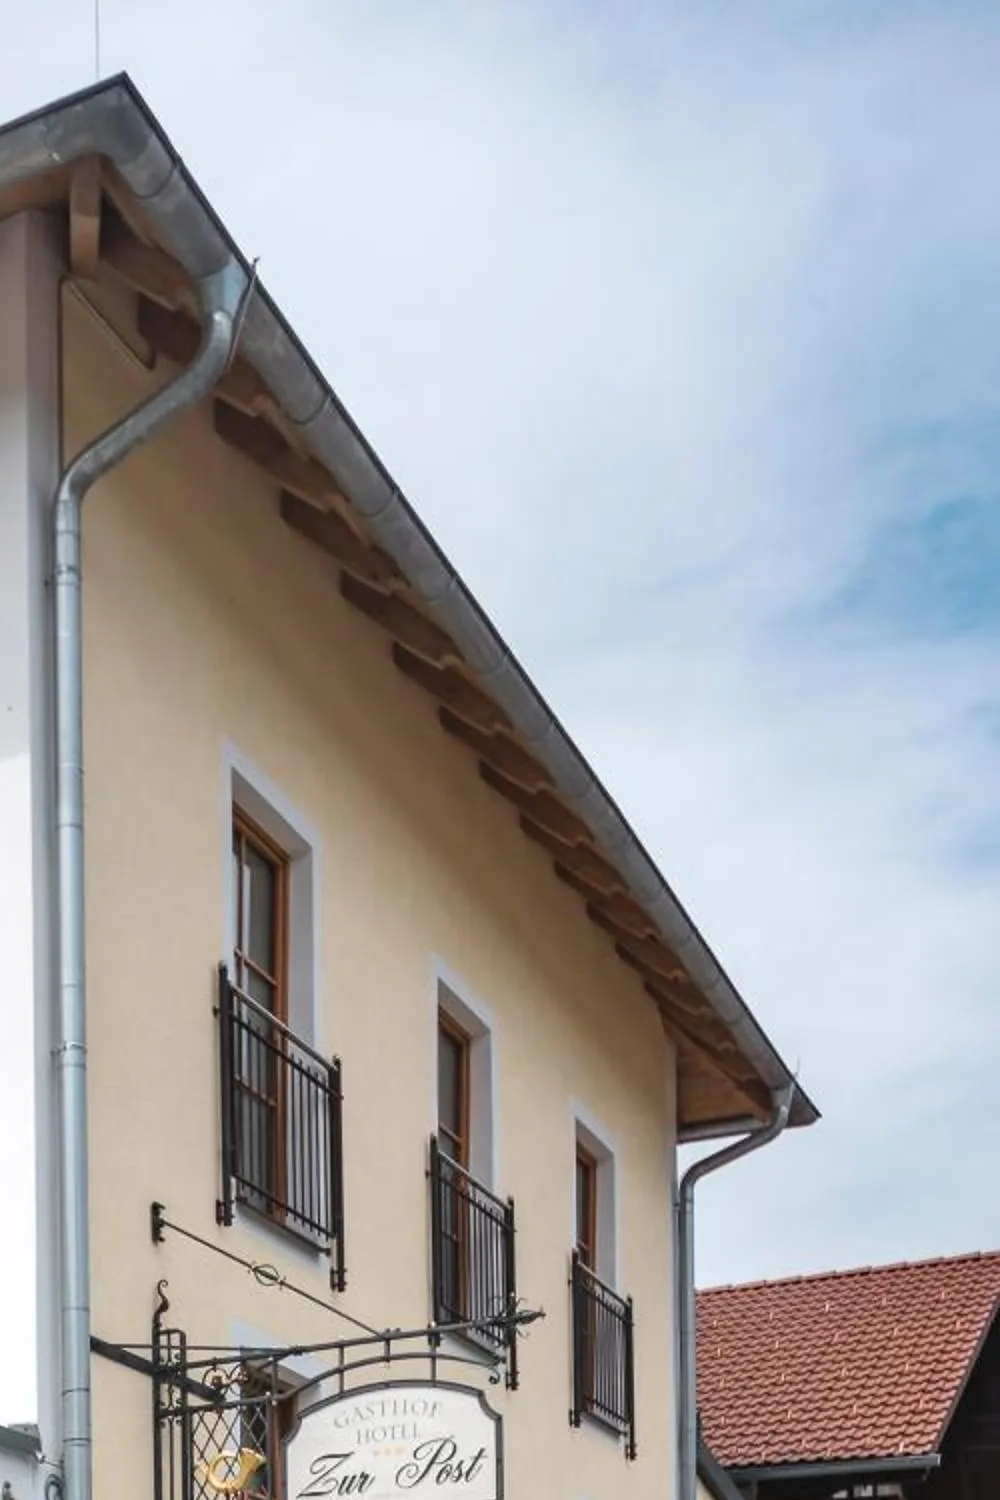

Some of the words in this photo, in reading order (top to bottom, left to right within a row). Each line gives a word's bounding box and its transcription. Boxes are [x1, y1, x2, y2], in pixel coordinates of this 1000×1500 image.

[333, 1397, 443, 1429] GASTHOF
[356, 1423, 418, 1445] HOTEL
[296, 1452, 376, 1499] Zur
[395, 1435, 488, 1489] Post
